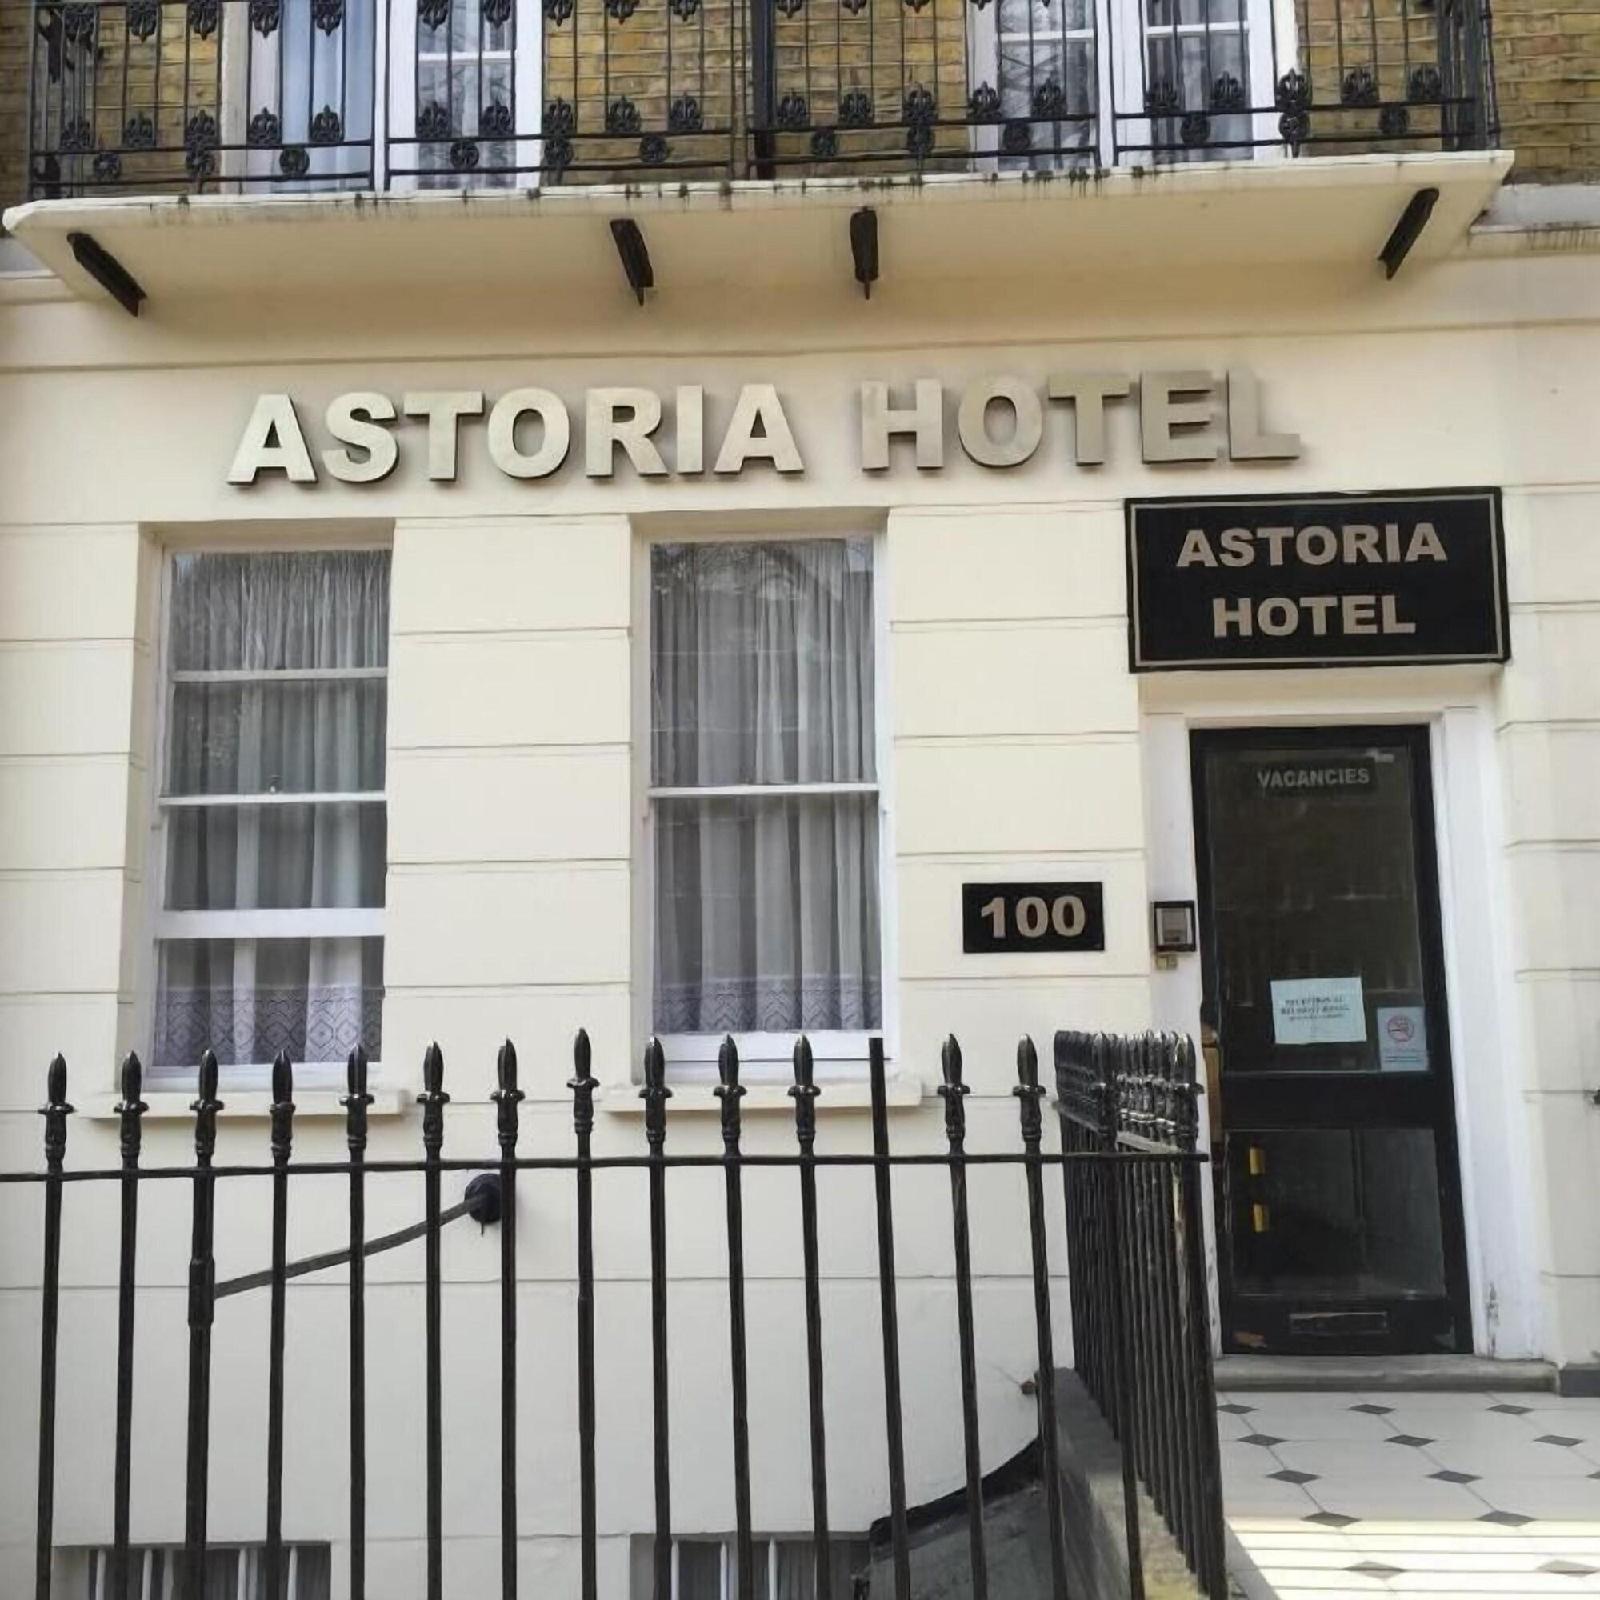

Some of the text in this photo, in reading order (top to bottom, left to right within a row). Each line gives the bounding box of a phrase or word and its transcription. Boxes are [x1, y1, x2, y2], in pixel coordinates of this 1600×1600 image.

[226, 370, 1301, 485] ASTORIA HOTEL
[1176, 522, 1447, 568] ASTORIA
[1213, 594, 1416, 638] HOTEL
[1257, 768, 1370, 788] VACANCIES
[981, 895, 1086, 938] 100
